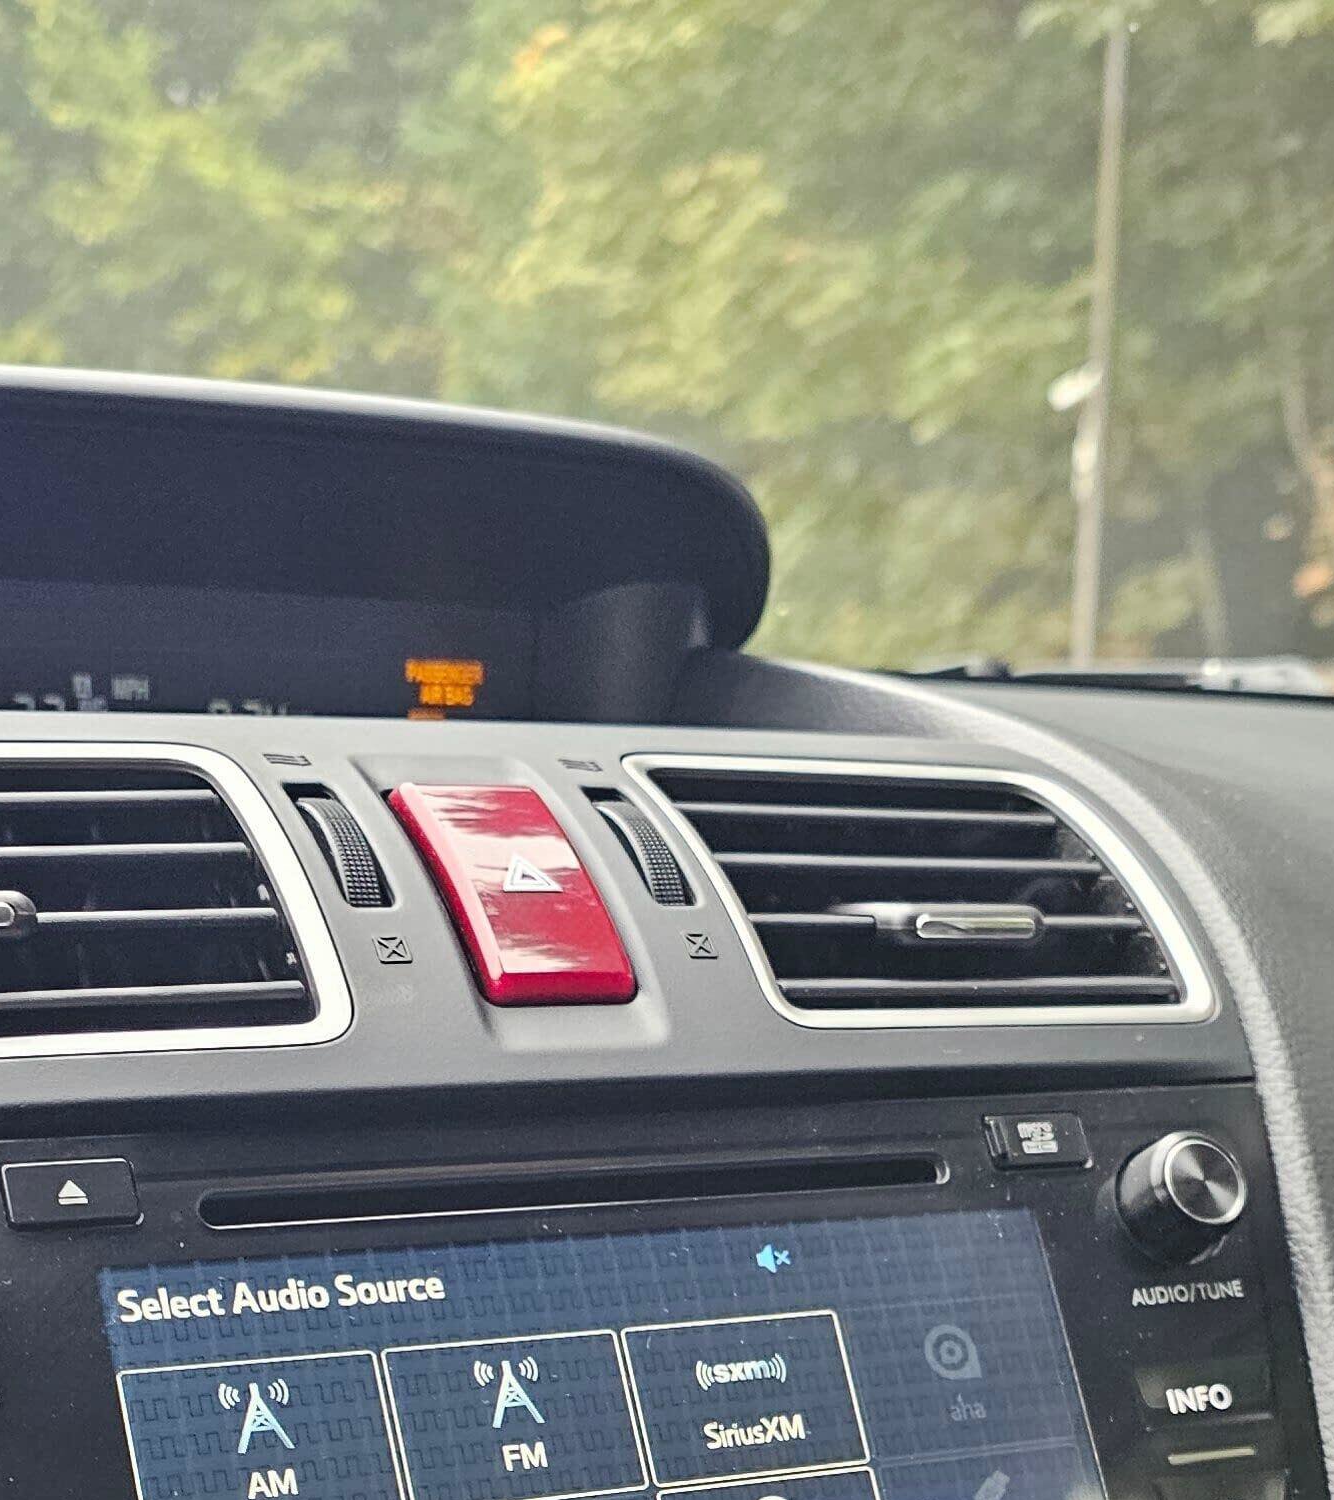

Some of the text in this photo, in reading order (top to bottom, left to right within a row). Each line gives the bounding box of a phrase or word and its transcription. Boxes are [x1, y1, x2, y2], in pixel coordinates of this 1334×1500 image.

[117, 1273, 446, 1323] Select Audio Source
[1131, 1280, 1244, 1307] AUDIO/TUNE
[1166, 1383, 1233, 1413] INFO
[704, 1414, 806, 1450] SiriusXM
[502, 1442, 549, 1471] FM
[247, 1468, 299, 1499] AM
